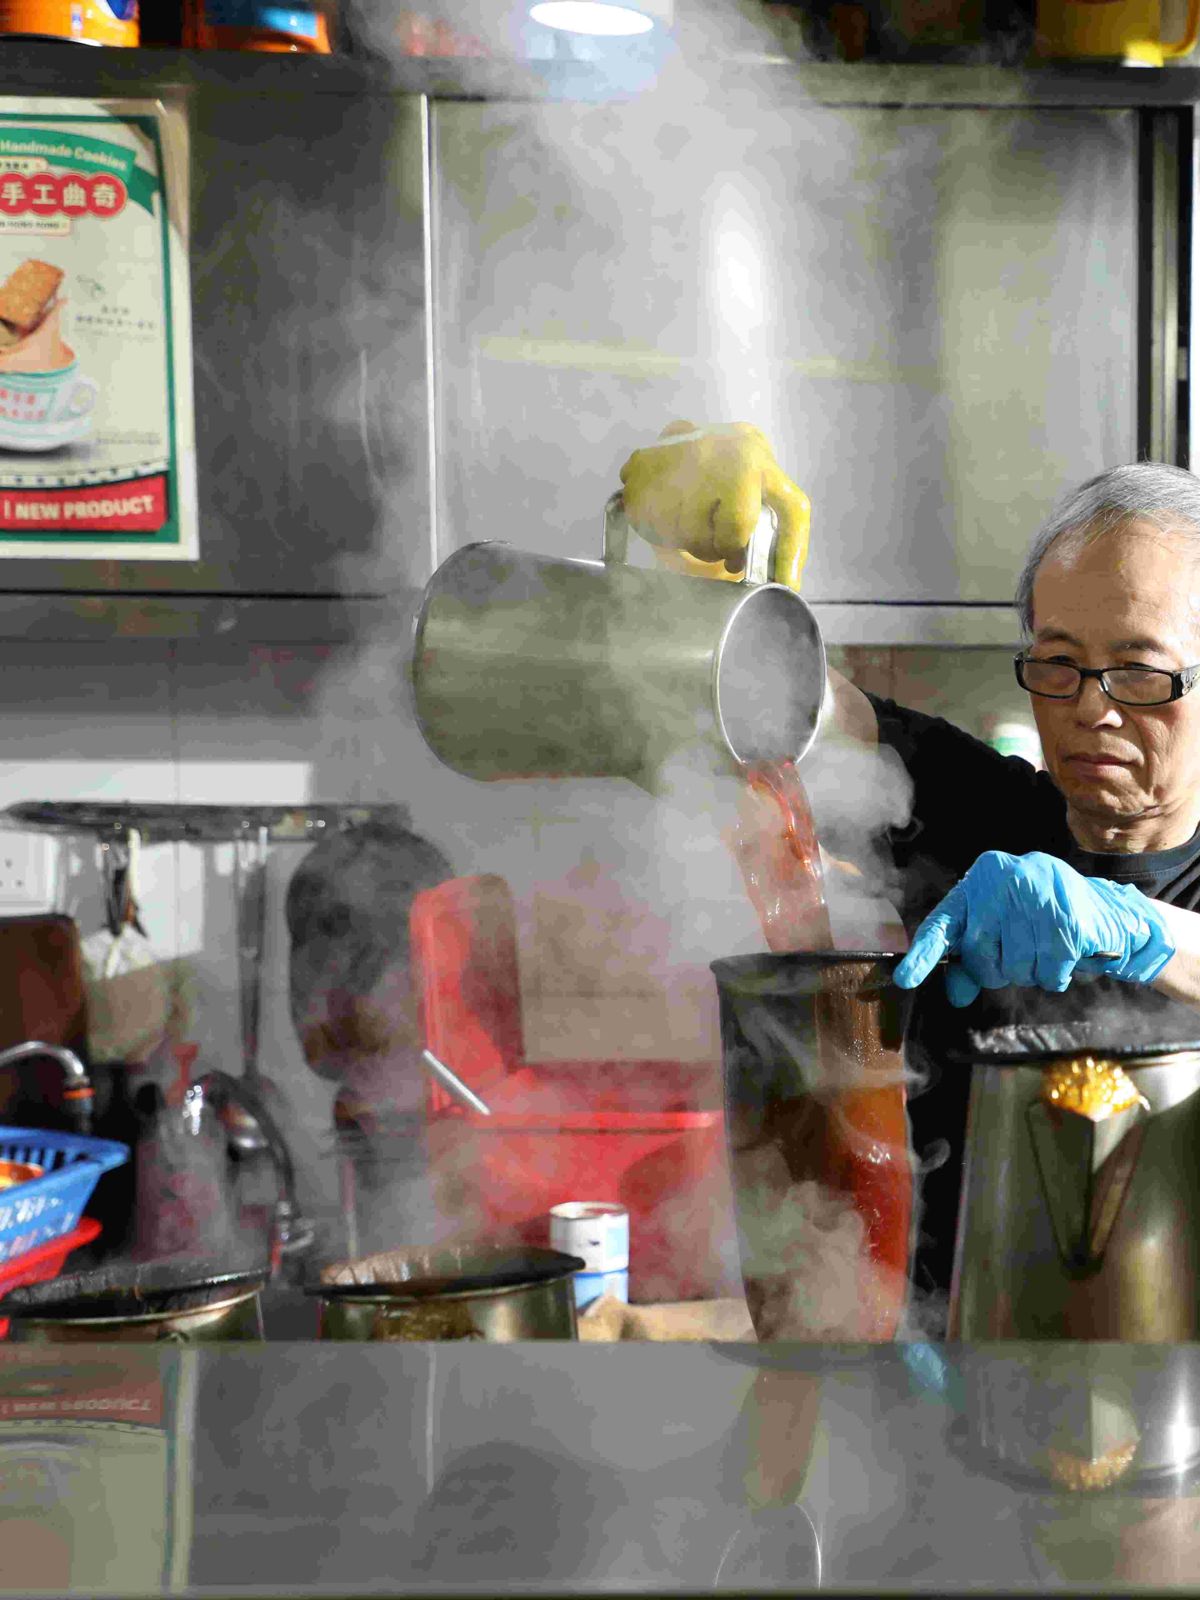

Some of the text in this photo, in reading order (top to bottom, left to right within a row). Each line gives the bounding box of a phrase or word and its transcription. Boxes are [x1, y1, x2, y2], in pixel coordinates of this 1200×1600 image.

[74, 147, 128, 170] Cookies
[1, 181, 117, 209] 手工曲奇
[15, 494, 155, 520] NEW PRODUCT
